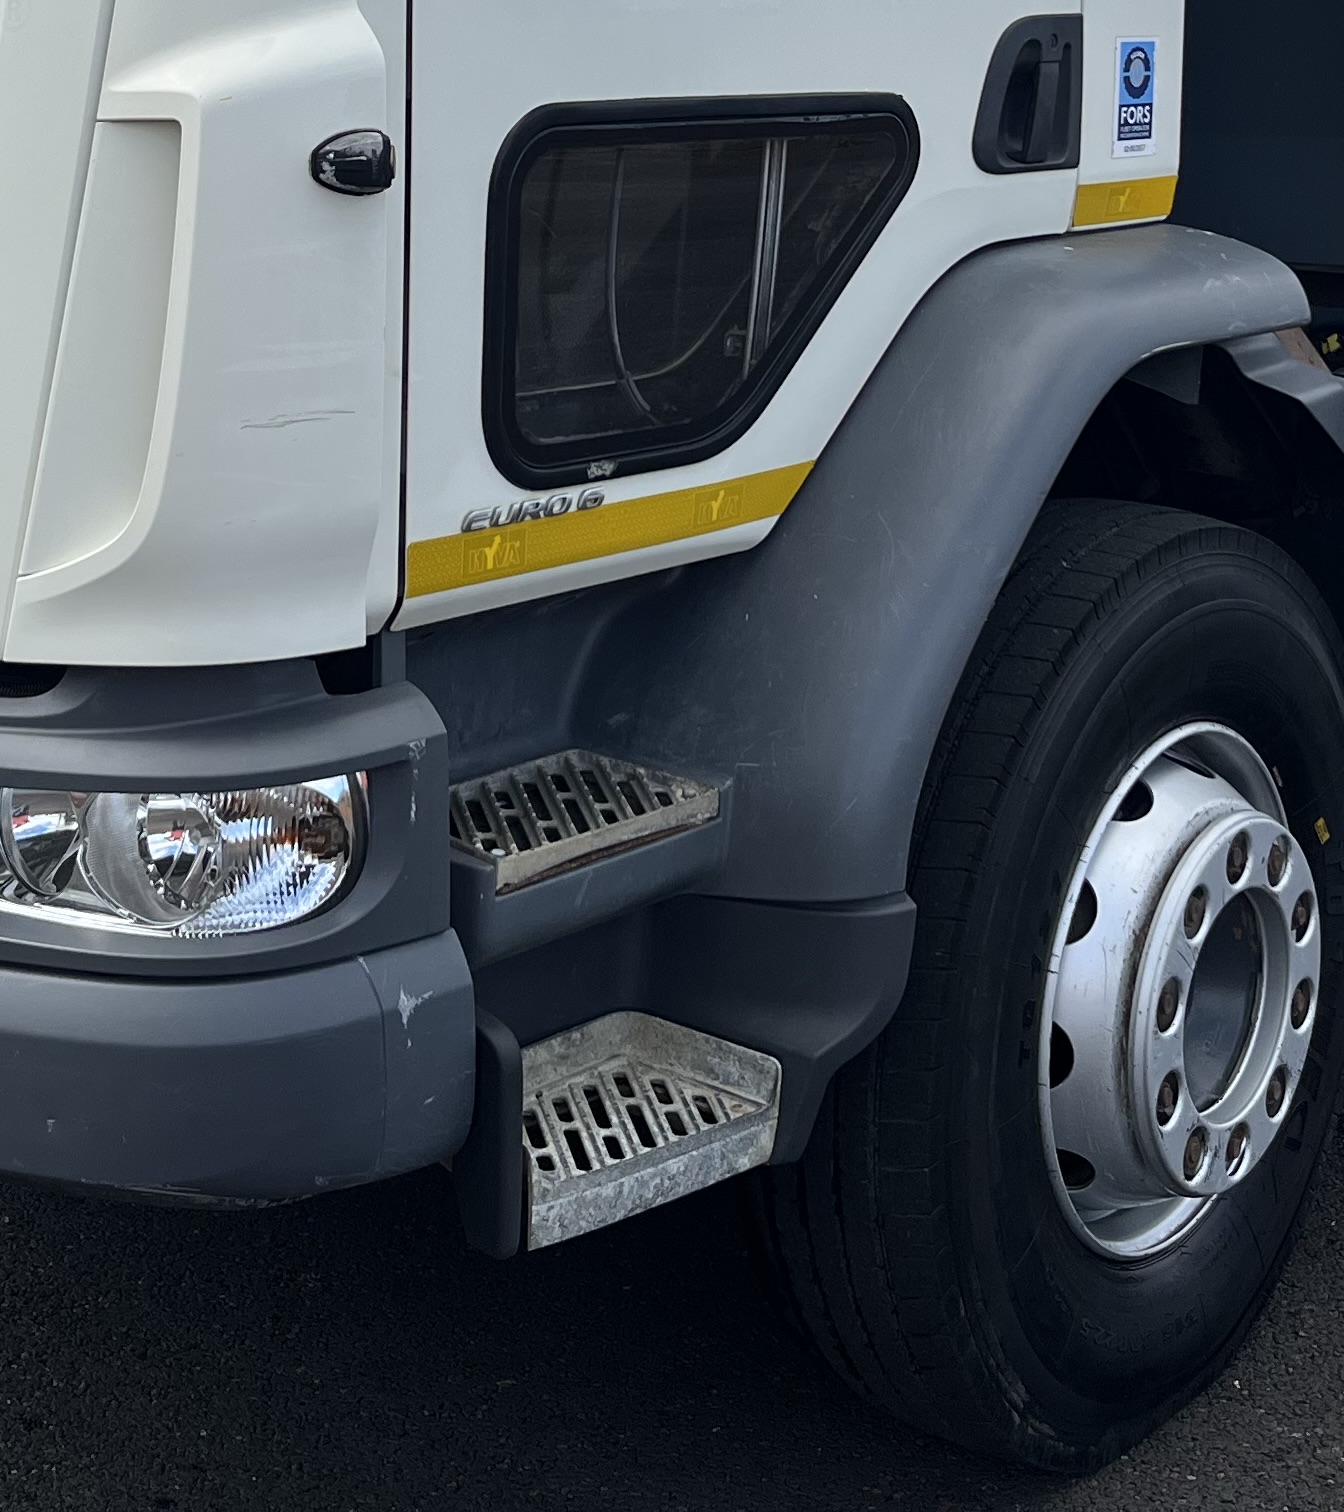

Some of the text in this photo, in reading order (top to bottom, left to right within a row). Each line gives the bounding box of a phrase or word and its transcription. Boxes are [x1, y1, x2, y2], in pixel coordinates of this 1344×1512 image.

[1120, 105, 1151, 125] FORS
[461, 485, 606, 534] EURO 6
